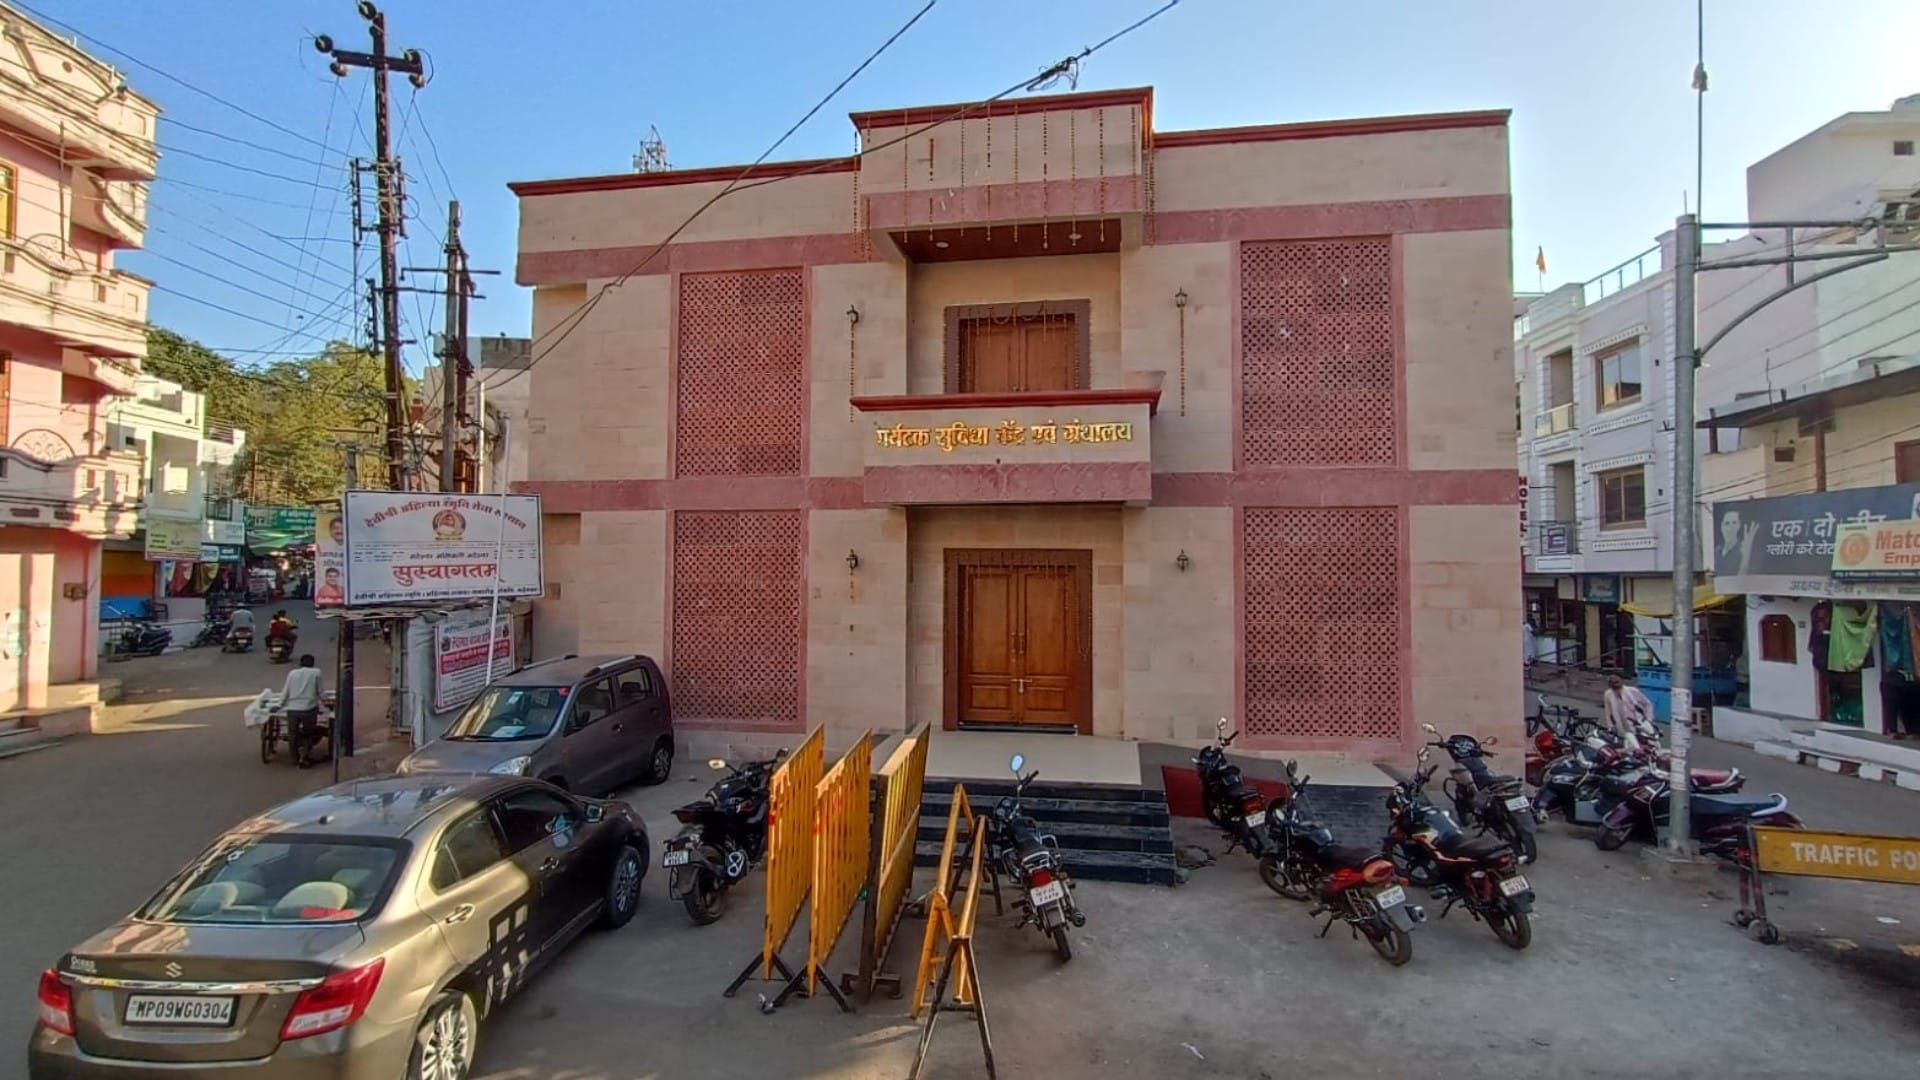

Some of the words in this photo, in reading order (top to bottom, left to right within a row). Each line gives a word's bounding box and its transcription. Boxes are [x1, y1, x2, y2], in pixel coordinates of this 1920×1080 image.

[1772, 519, 1804, 537] एक
[1813, 511, 1836, 537] दो
[1791, 841, 1879, 867] TRAFFIC
[1890, 850, 1920, 871] PO
[136, 1001, 230, 1019] MP09WG0304
